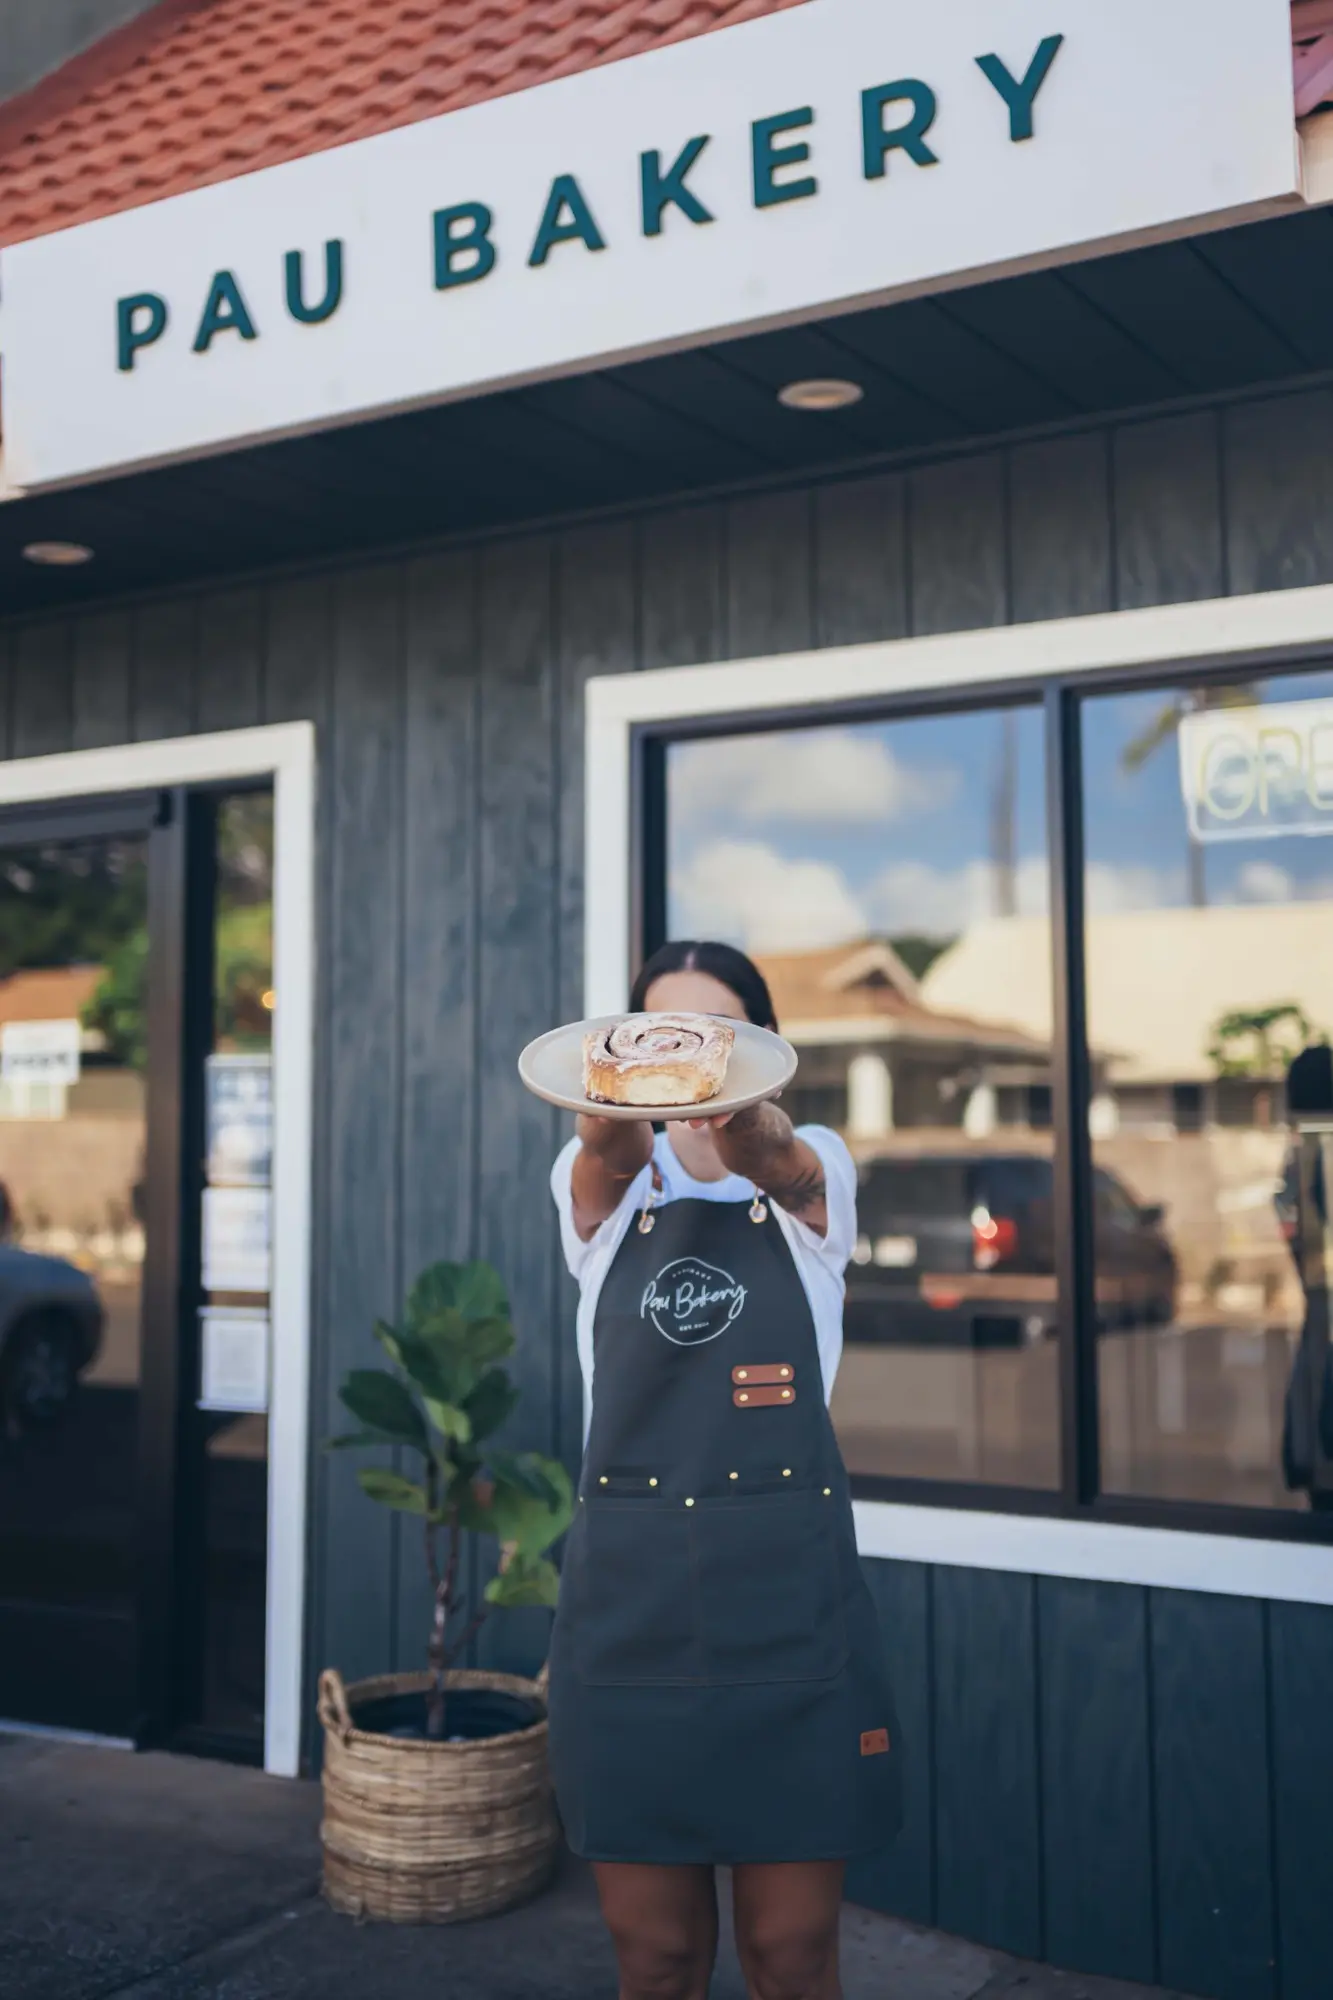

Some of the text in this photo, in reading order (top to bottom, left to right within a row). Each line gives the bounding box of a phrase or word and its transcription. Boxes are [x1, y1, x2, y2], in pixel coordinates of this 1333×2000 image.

[116, 34, 1062, 371] PAU BAKERY
[640, 1280, 748, 1320] Pau Bakery
